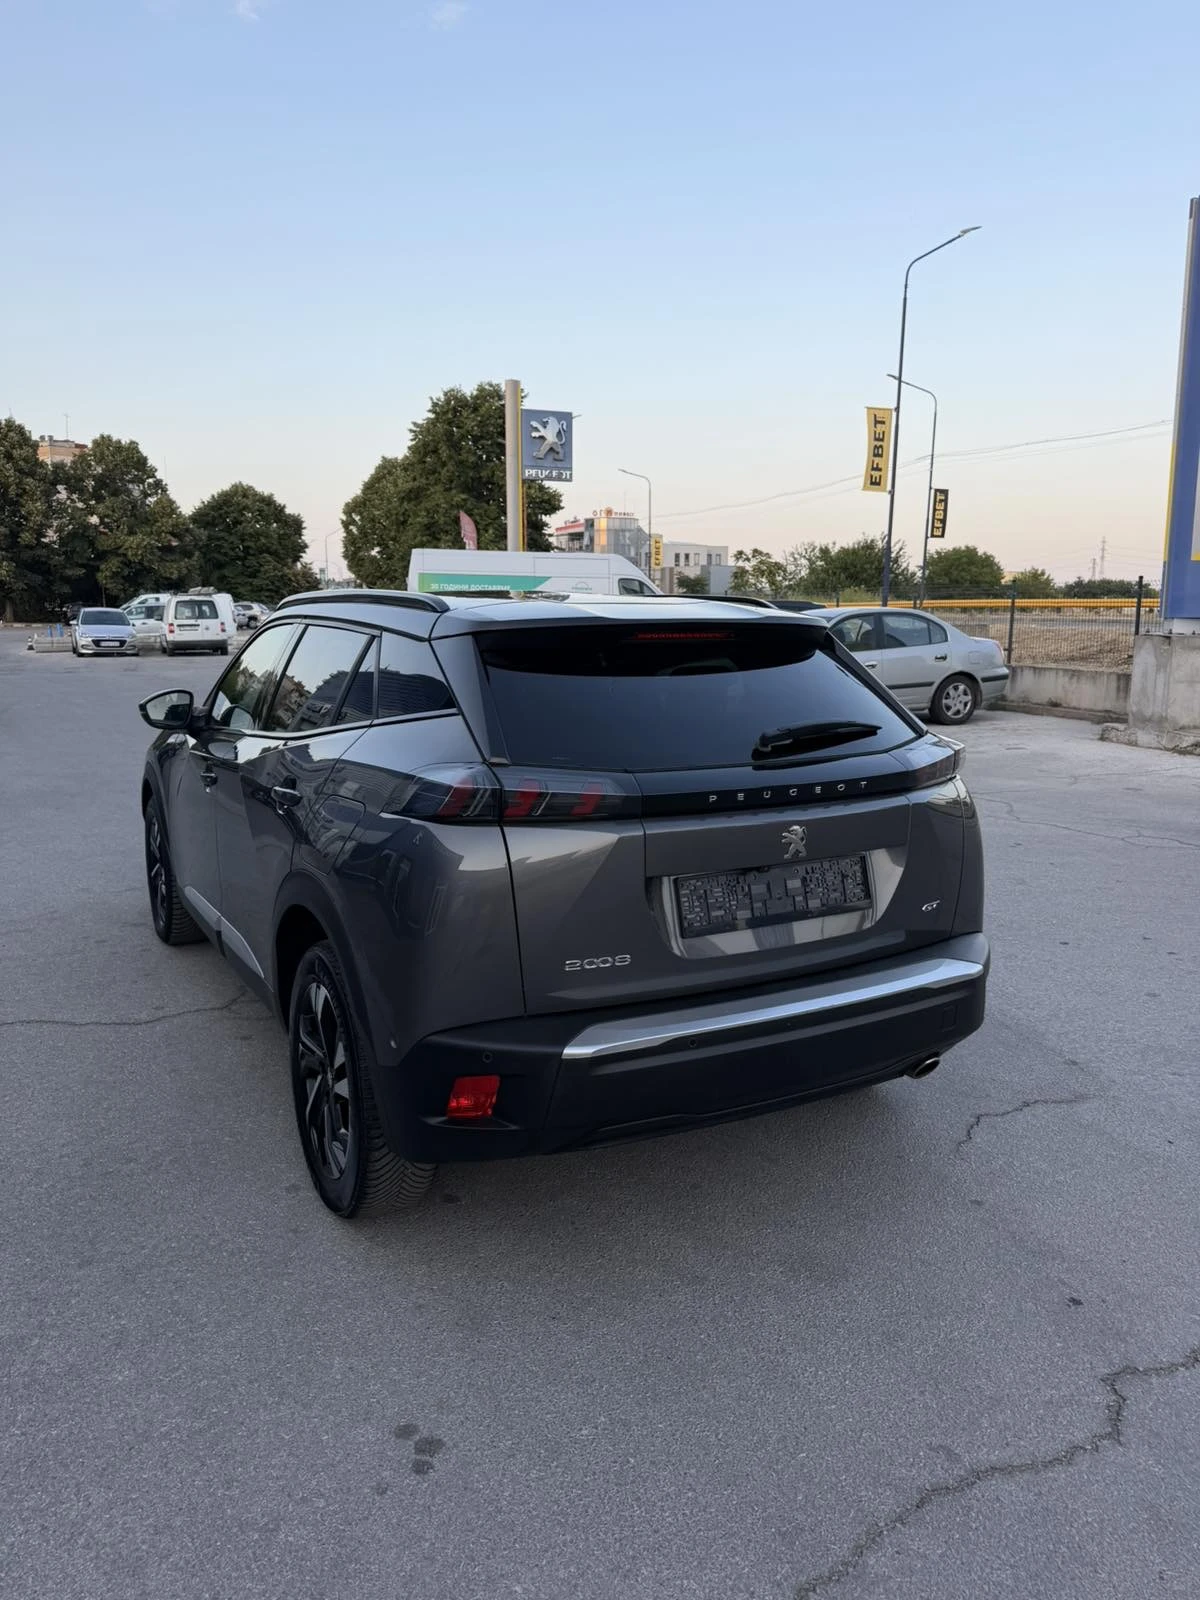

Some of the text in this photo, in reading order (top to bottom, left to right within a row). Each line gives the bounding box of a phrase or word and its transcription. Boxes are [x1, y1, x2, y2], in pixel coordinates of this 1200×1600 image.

[869, 413, 886, 486] EFBET
[933, 491, 946, 536] EFBET
[709, 781, 867, 803] PEUGEOT
[922, 900, 940, 912] GT
[564, 954, 631, 971] 2008
